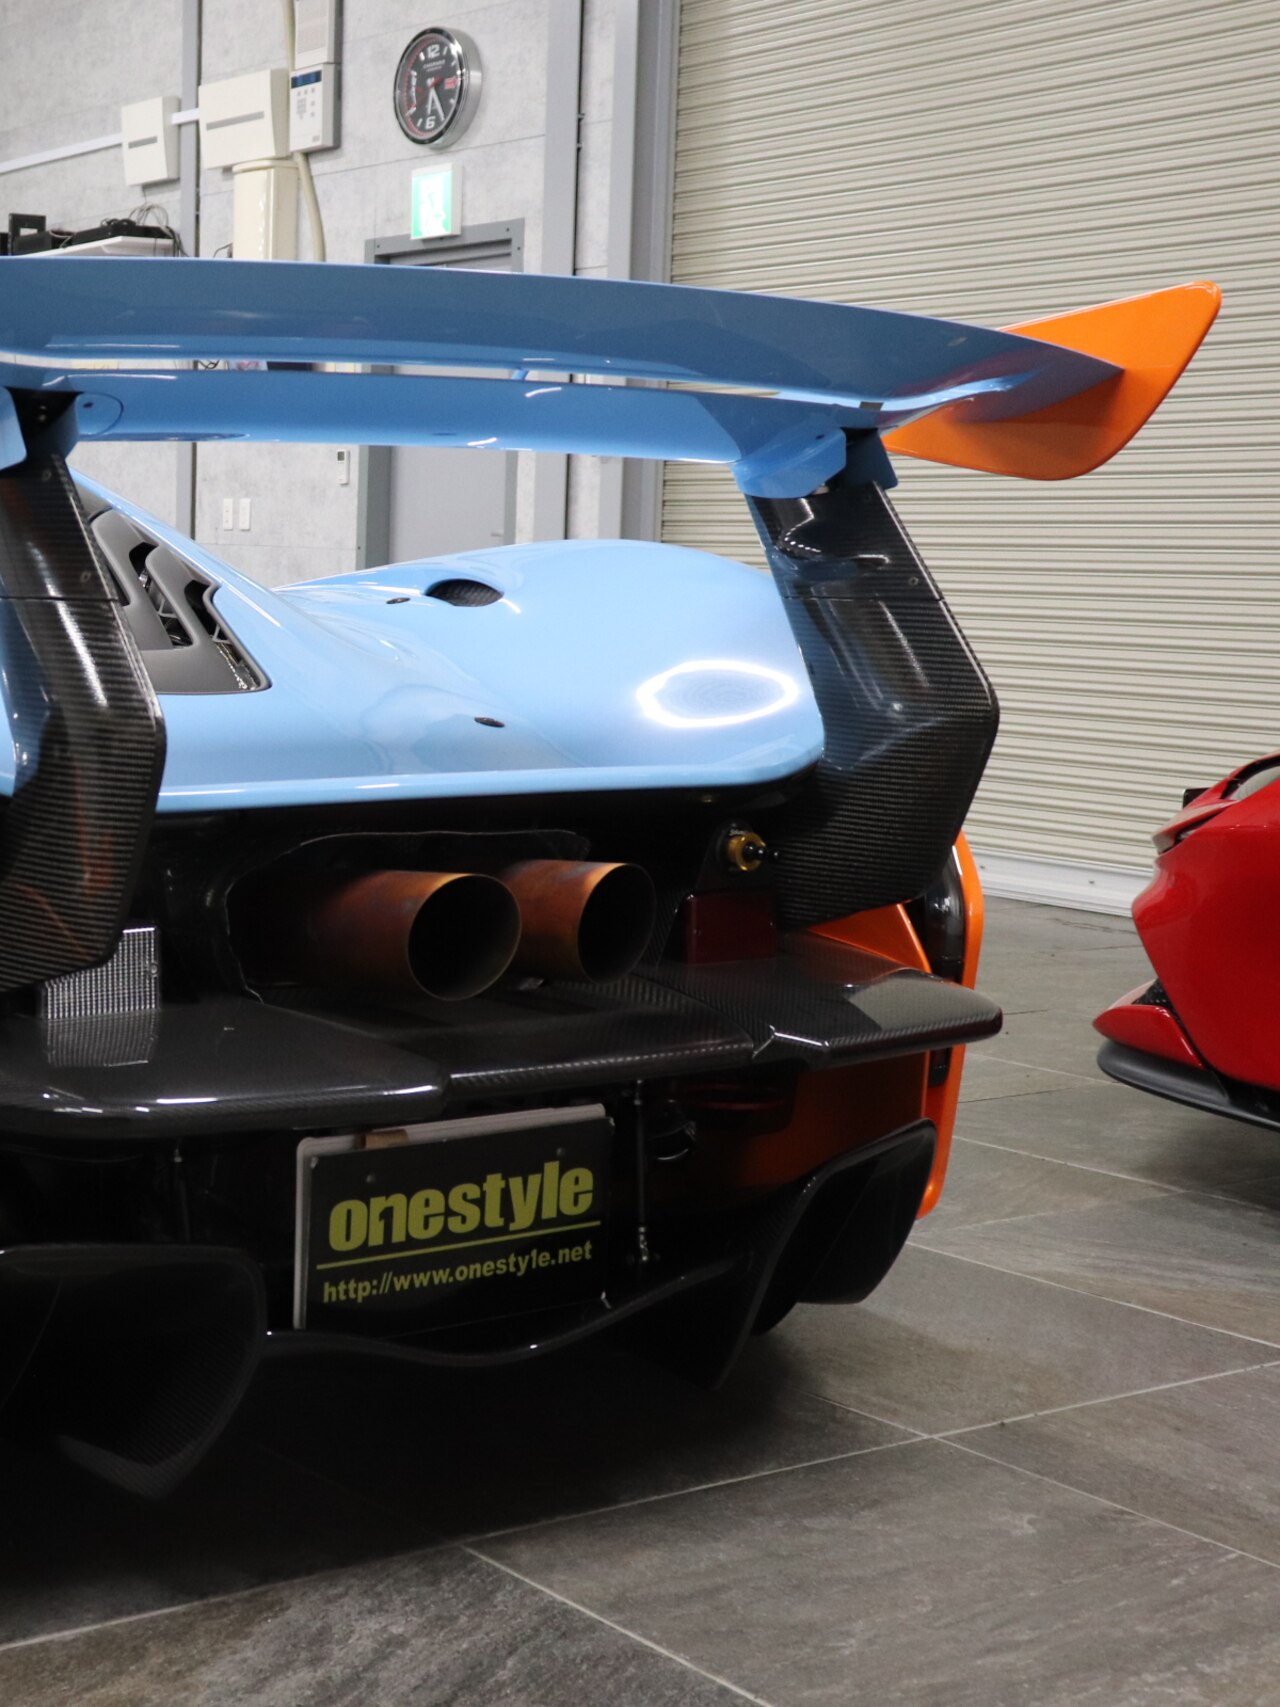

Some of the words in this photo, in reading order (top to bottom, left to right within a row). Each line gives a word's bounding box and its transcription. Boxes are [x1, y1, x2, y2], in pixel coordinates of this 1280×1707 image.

[427, 44, 440, 59] 12
[425, 116, 436, 129] 6
[328, 1160, 594, 1252] onestyle
